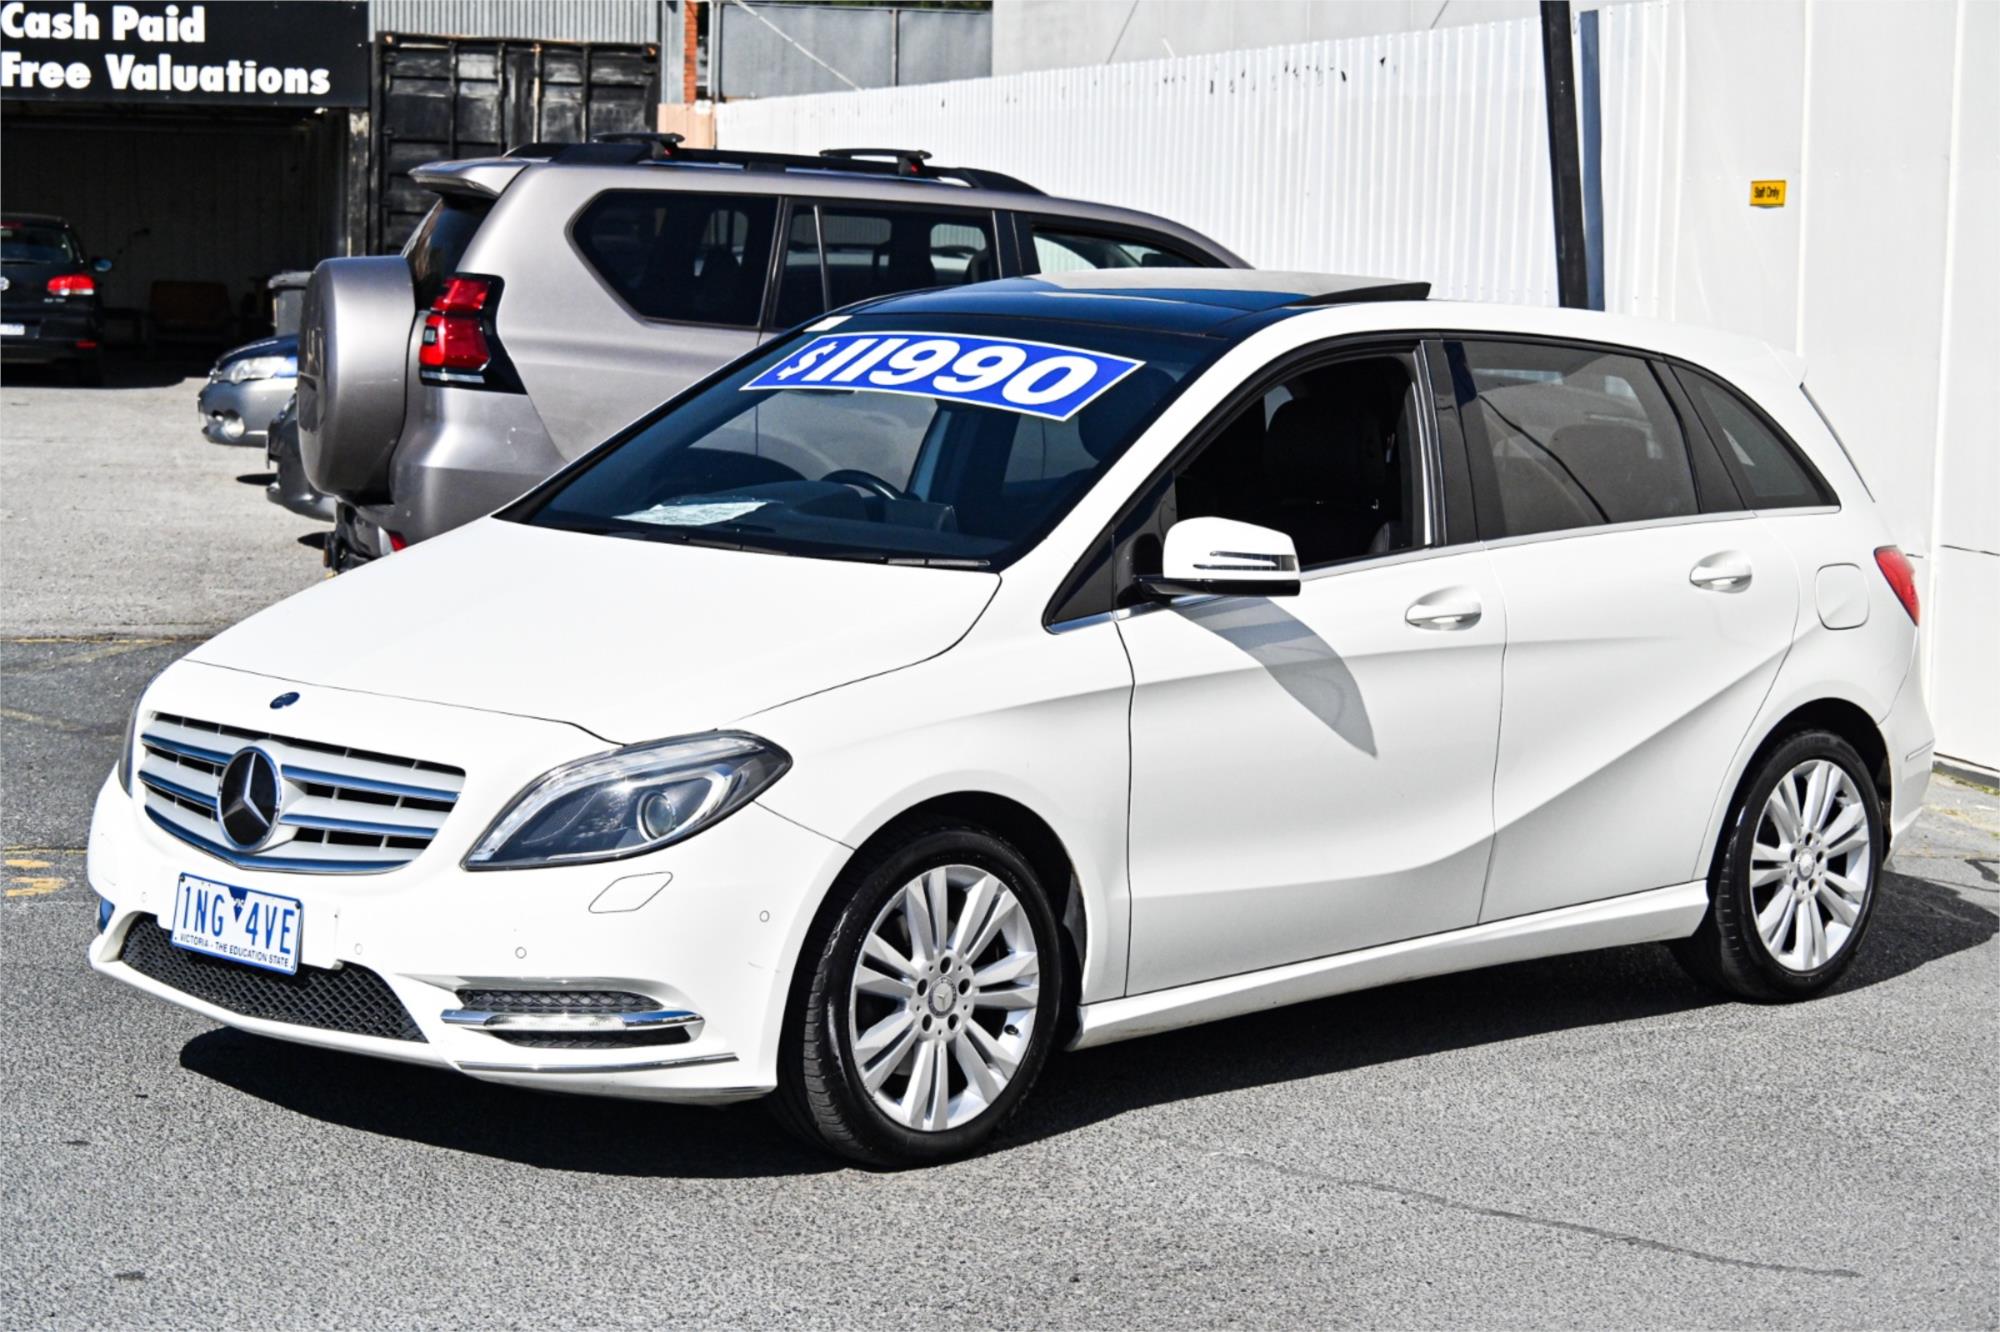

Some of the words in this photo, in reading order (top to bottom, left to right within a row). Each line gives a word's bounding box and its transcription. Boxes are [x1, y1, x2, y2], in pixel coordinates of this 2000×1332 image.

[0, 2, 99, 40] Cash
[112, 5, 206, 43] Paid
[0, 52, 91, 89] Free
[105, 54, 331, 95] Valuations
[776, 338, 1098, 405] $11990
[183, 886, 225, 937] 1NG
[245, 901, 295, 955] 4VE
[180, 933, 209, 947] VICTORIA
[215, 941, 228, 953] THE
[229, 945, 268, 962] EDUCATION
[269, 955, 289, 968] STATE
